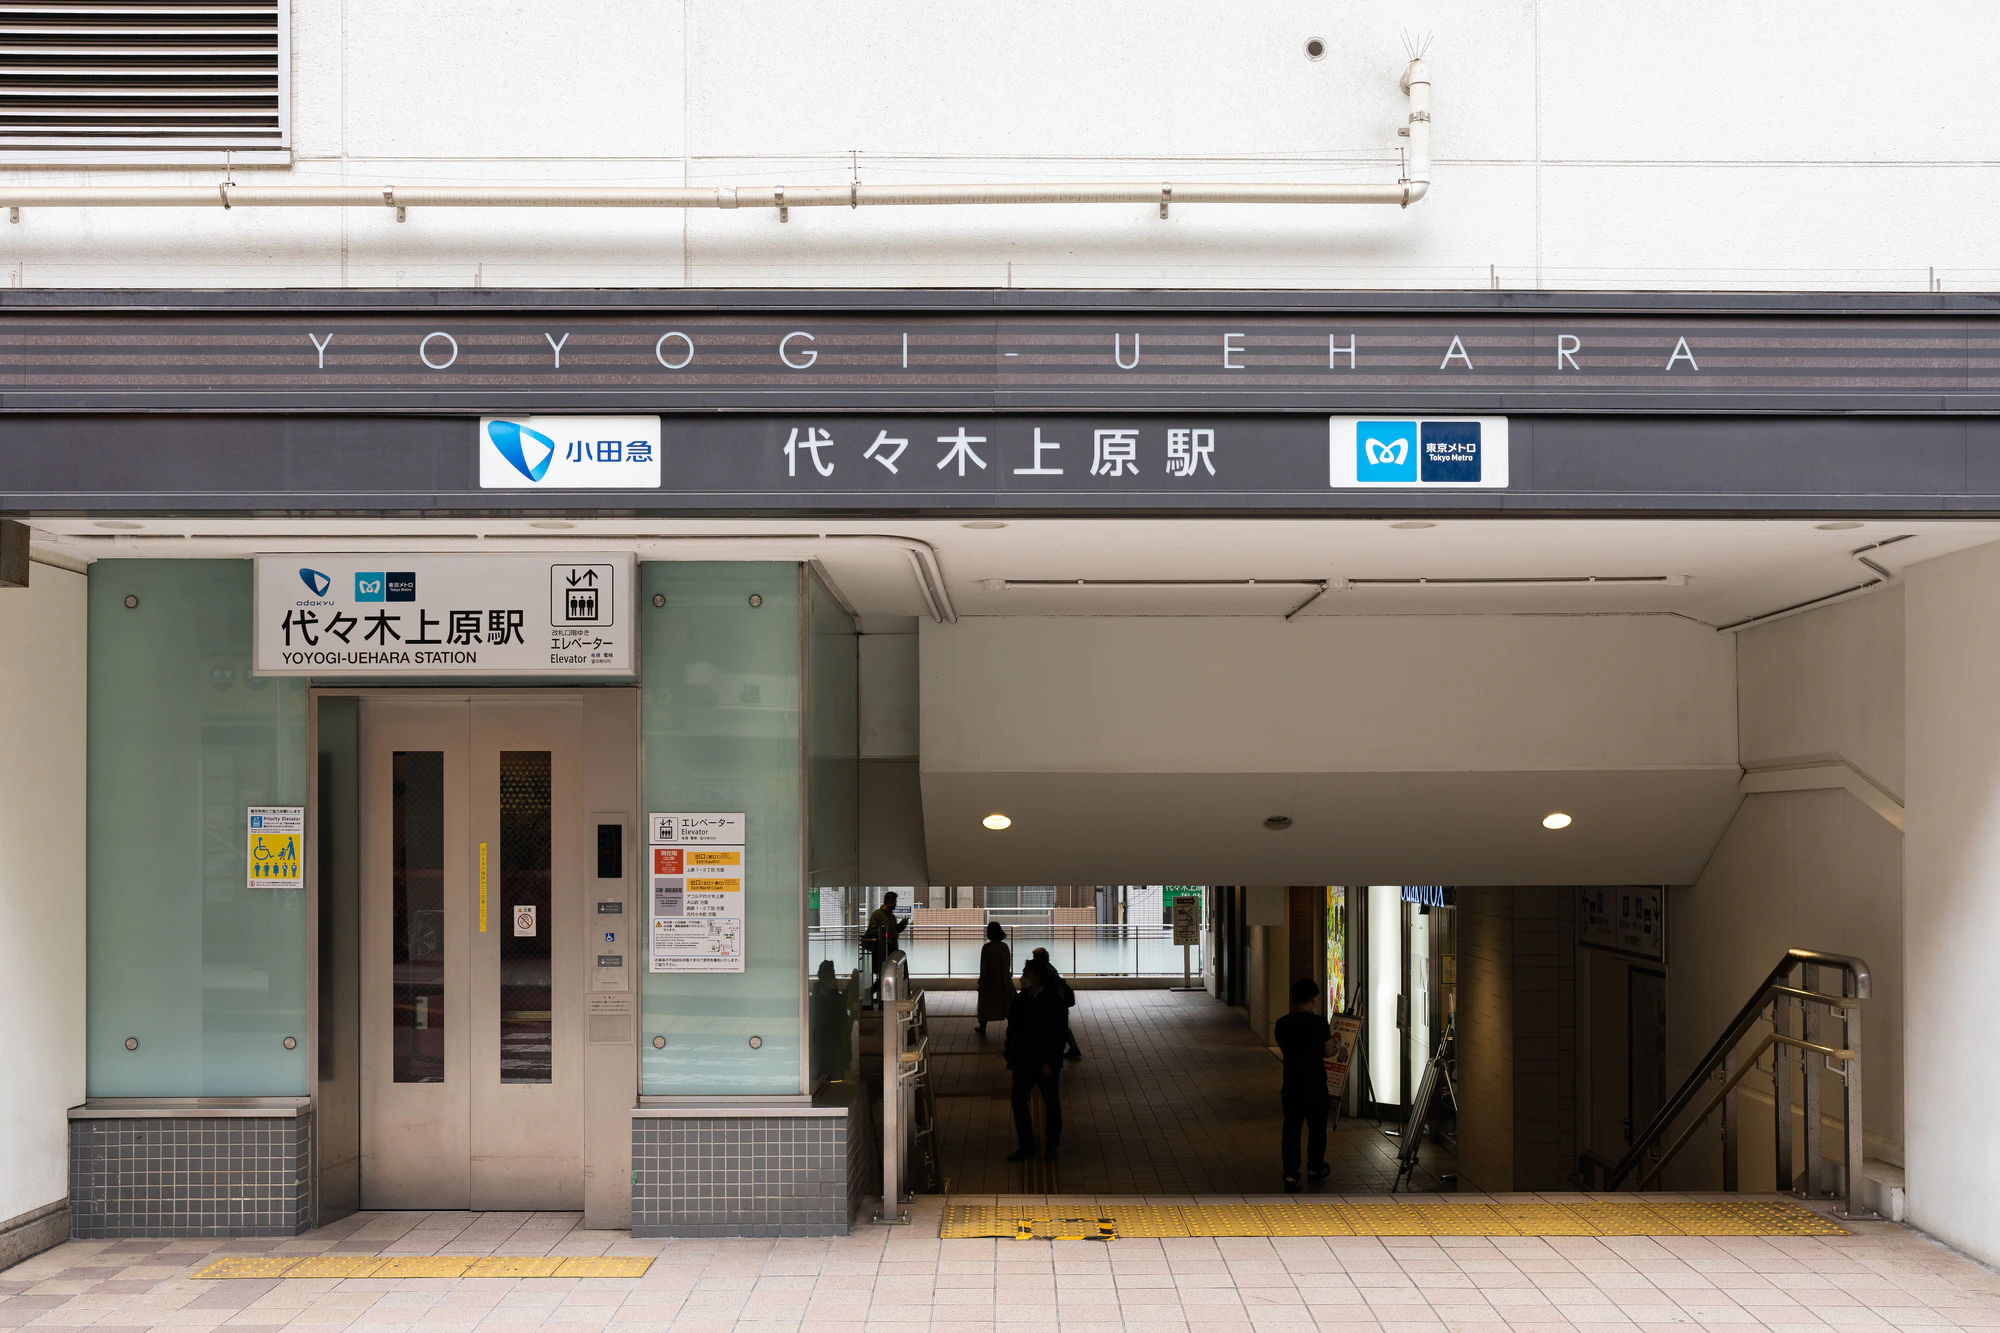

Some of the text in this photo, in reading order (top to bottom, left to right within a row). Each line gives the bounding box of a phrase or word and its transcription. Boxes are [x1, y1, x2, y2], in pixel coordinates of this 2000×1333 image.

[565, 439, 654, 464] 小田急
[783, 426, 1217, 479] 代々木上原駅
[1426, 443, 1475, 453] 東京メトロ
[1429, 453, 1473, 462] Tokyo Metro
[281, 608, 525, 646] 代々木上原駅
[550, 637, 613, 650] エレベーター
[282, 651, 477, 665] YOYOGI-UEHARA STATION
[550, 653, 587, 664] Elevator
[681, 818, 735, 828] エレベーター
[681, 828, 709, 836] Elevator
